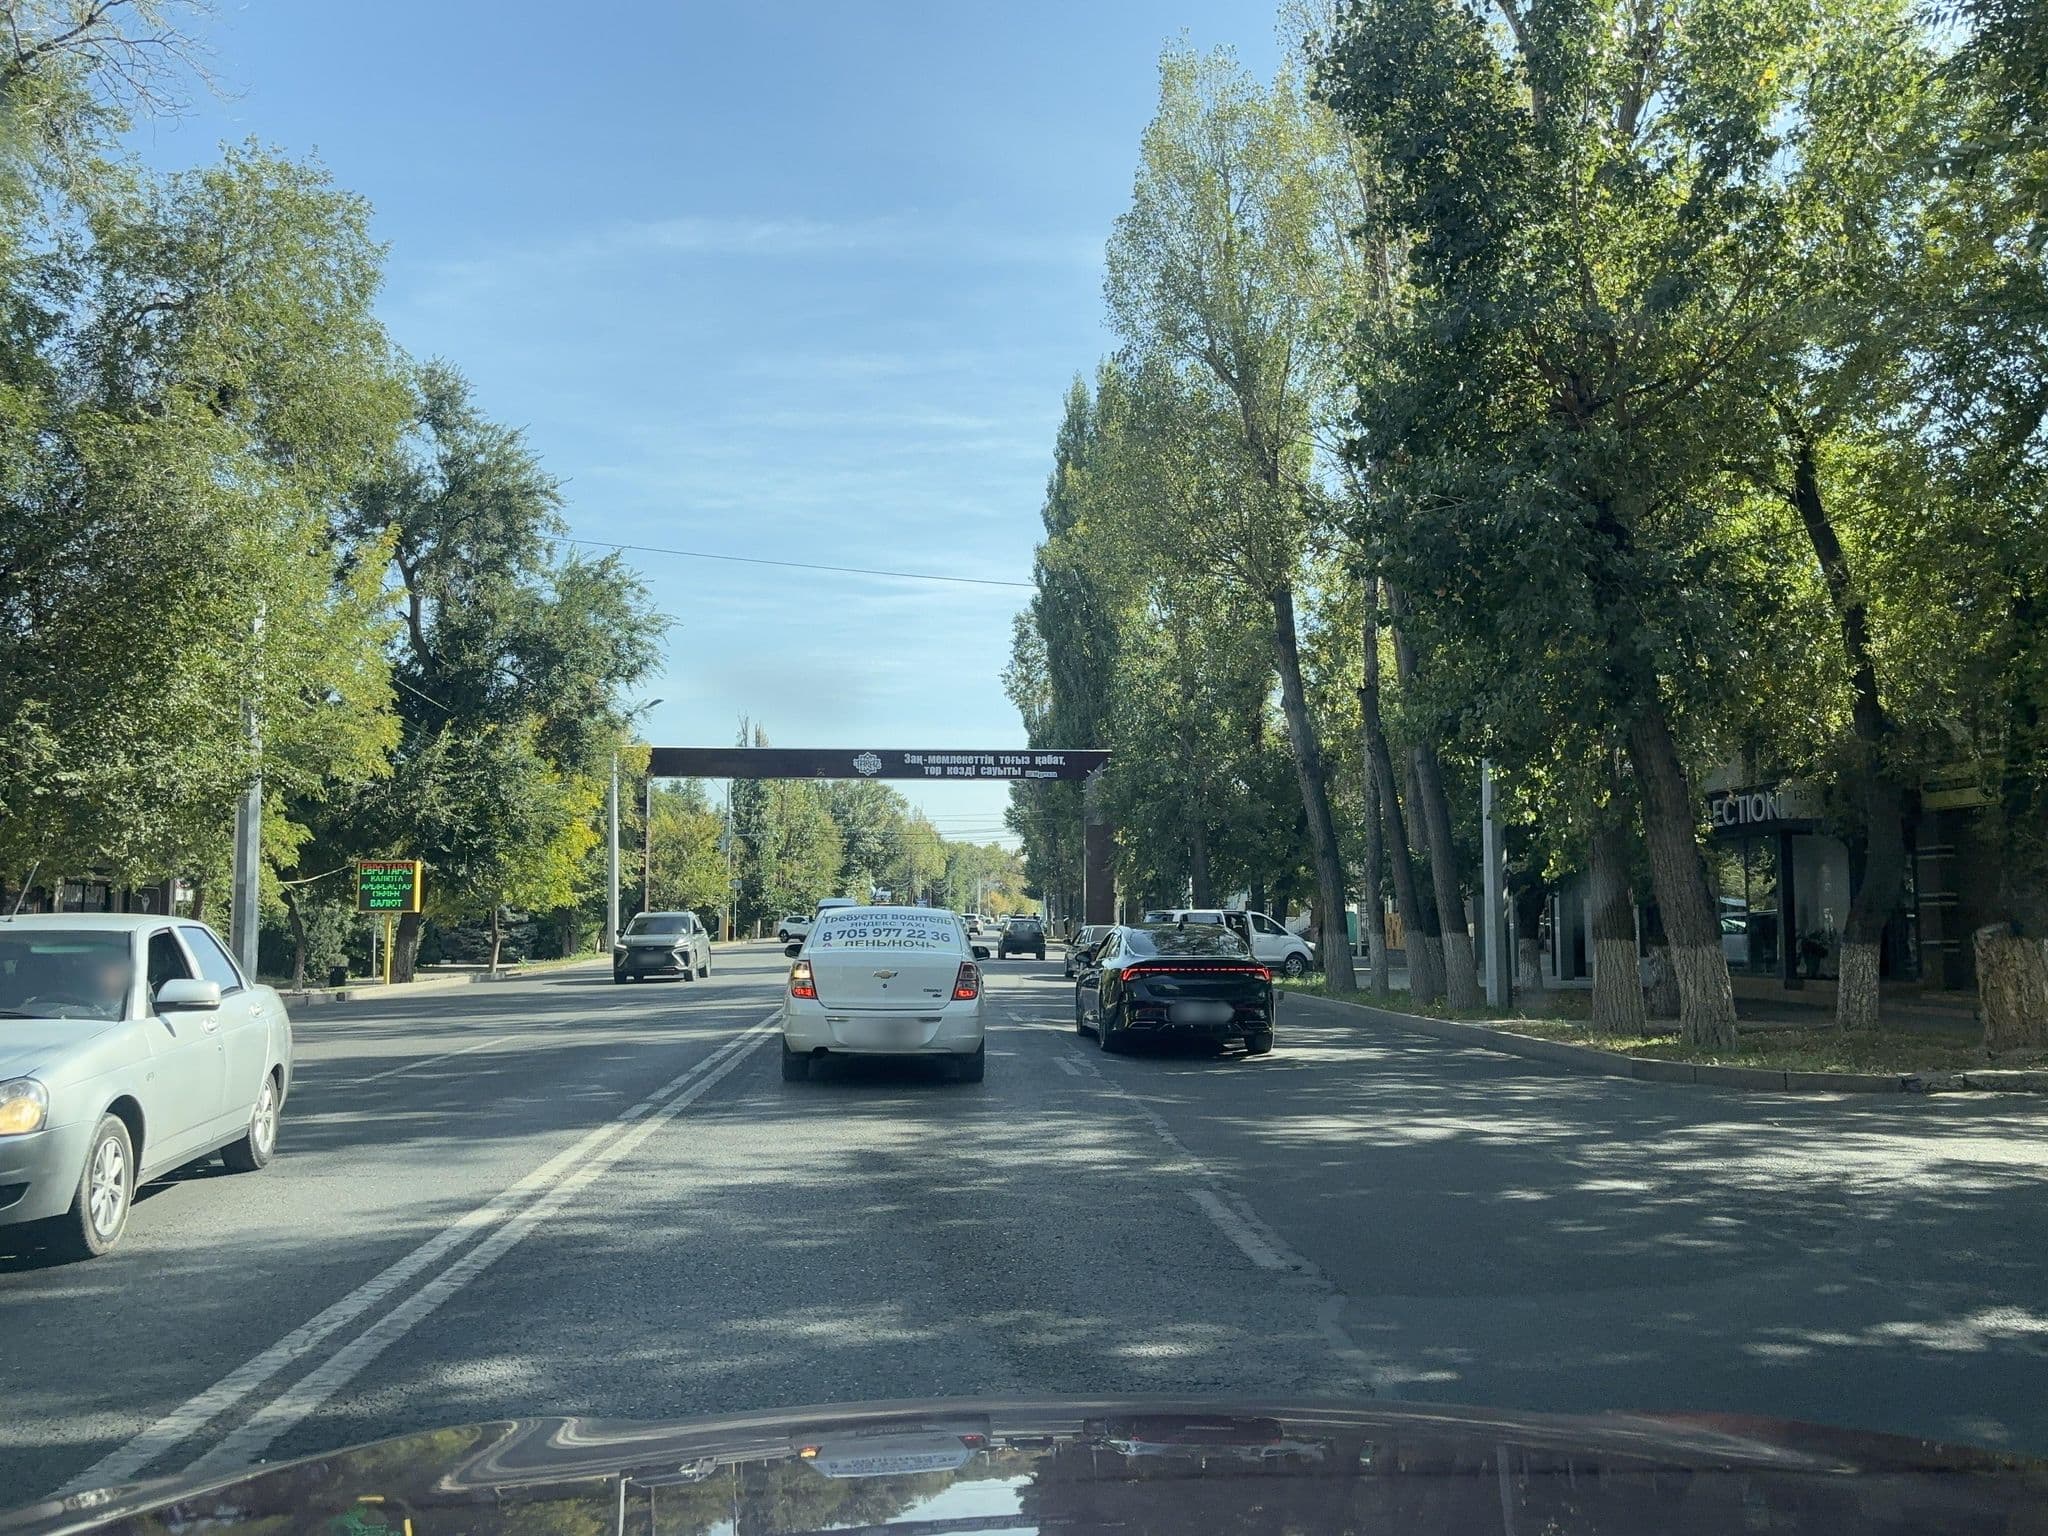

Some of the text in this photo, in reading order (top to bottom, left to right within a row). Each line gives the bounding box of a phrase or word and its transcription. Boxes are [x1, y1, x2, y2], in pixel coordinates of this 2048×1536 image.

[999, 754, 1031, 765] тоғыз
[924, 766, 942, 776] тор
[980, 766, 1021, 777] сауыты
[370, 899, 402, 907] ВАЛЮТ
[823, 913, 952, 925] Требуется водитель
[822, 928, 951, 942] 8 705 977 22 36
